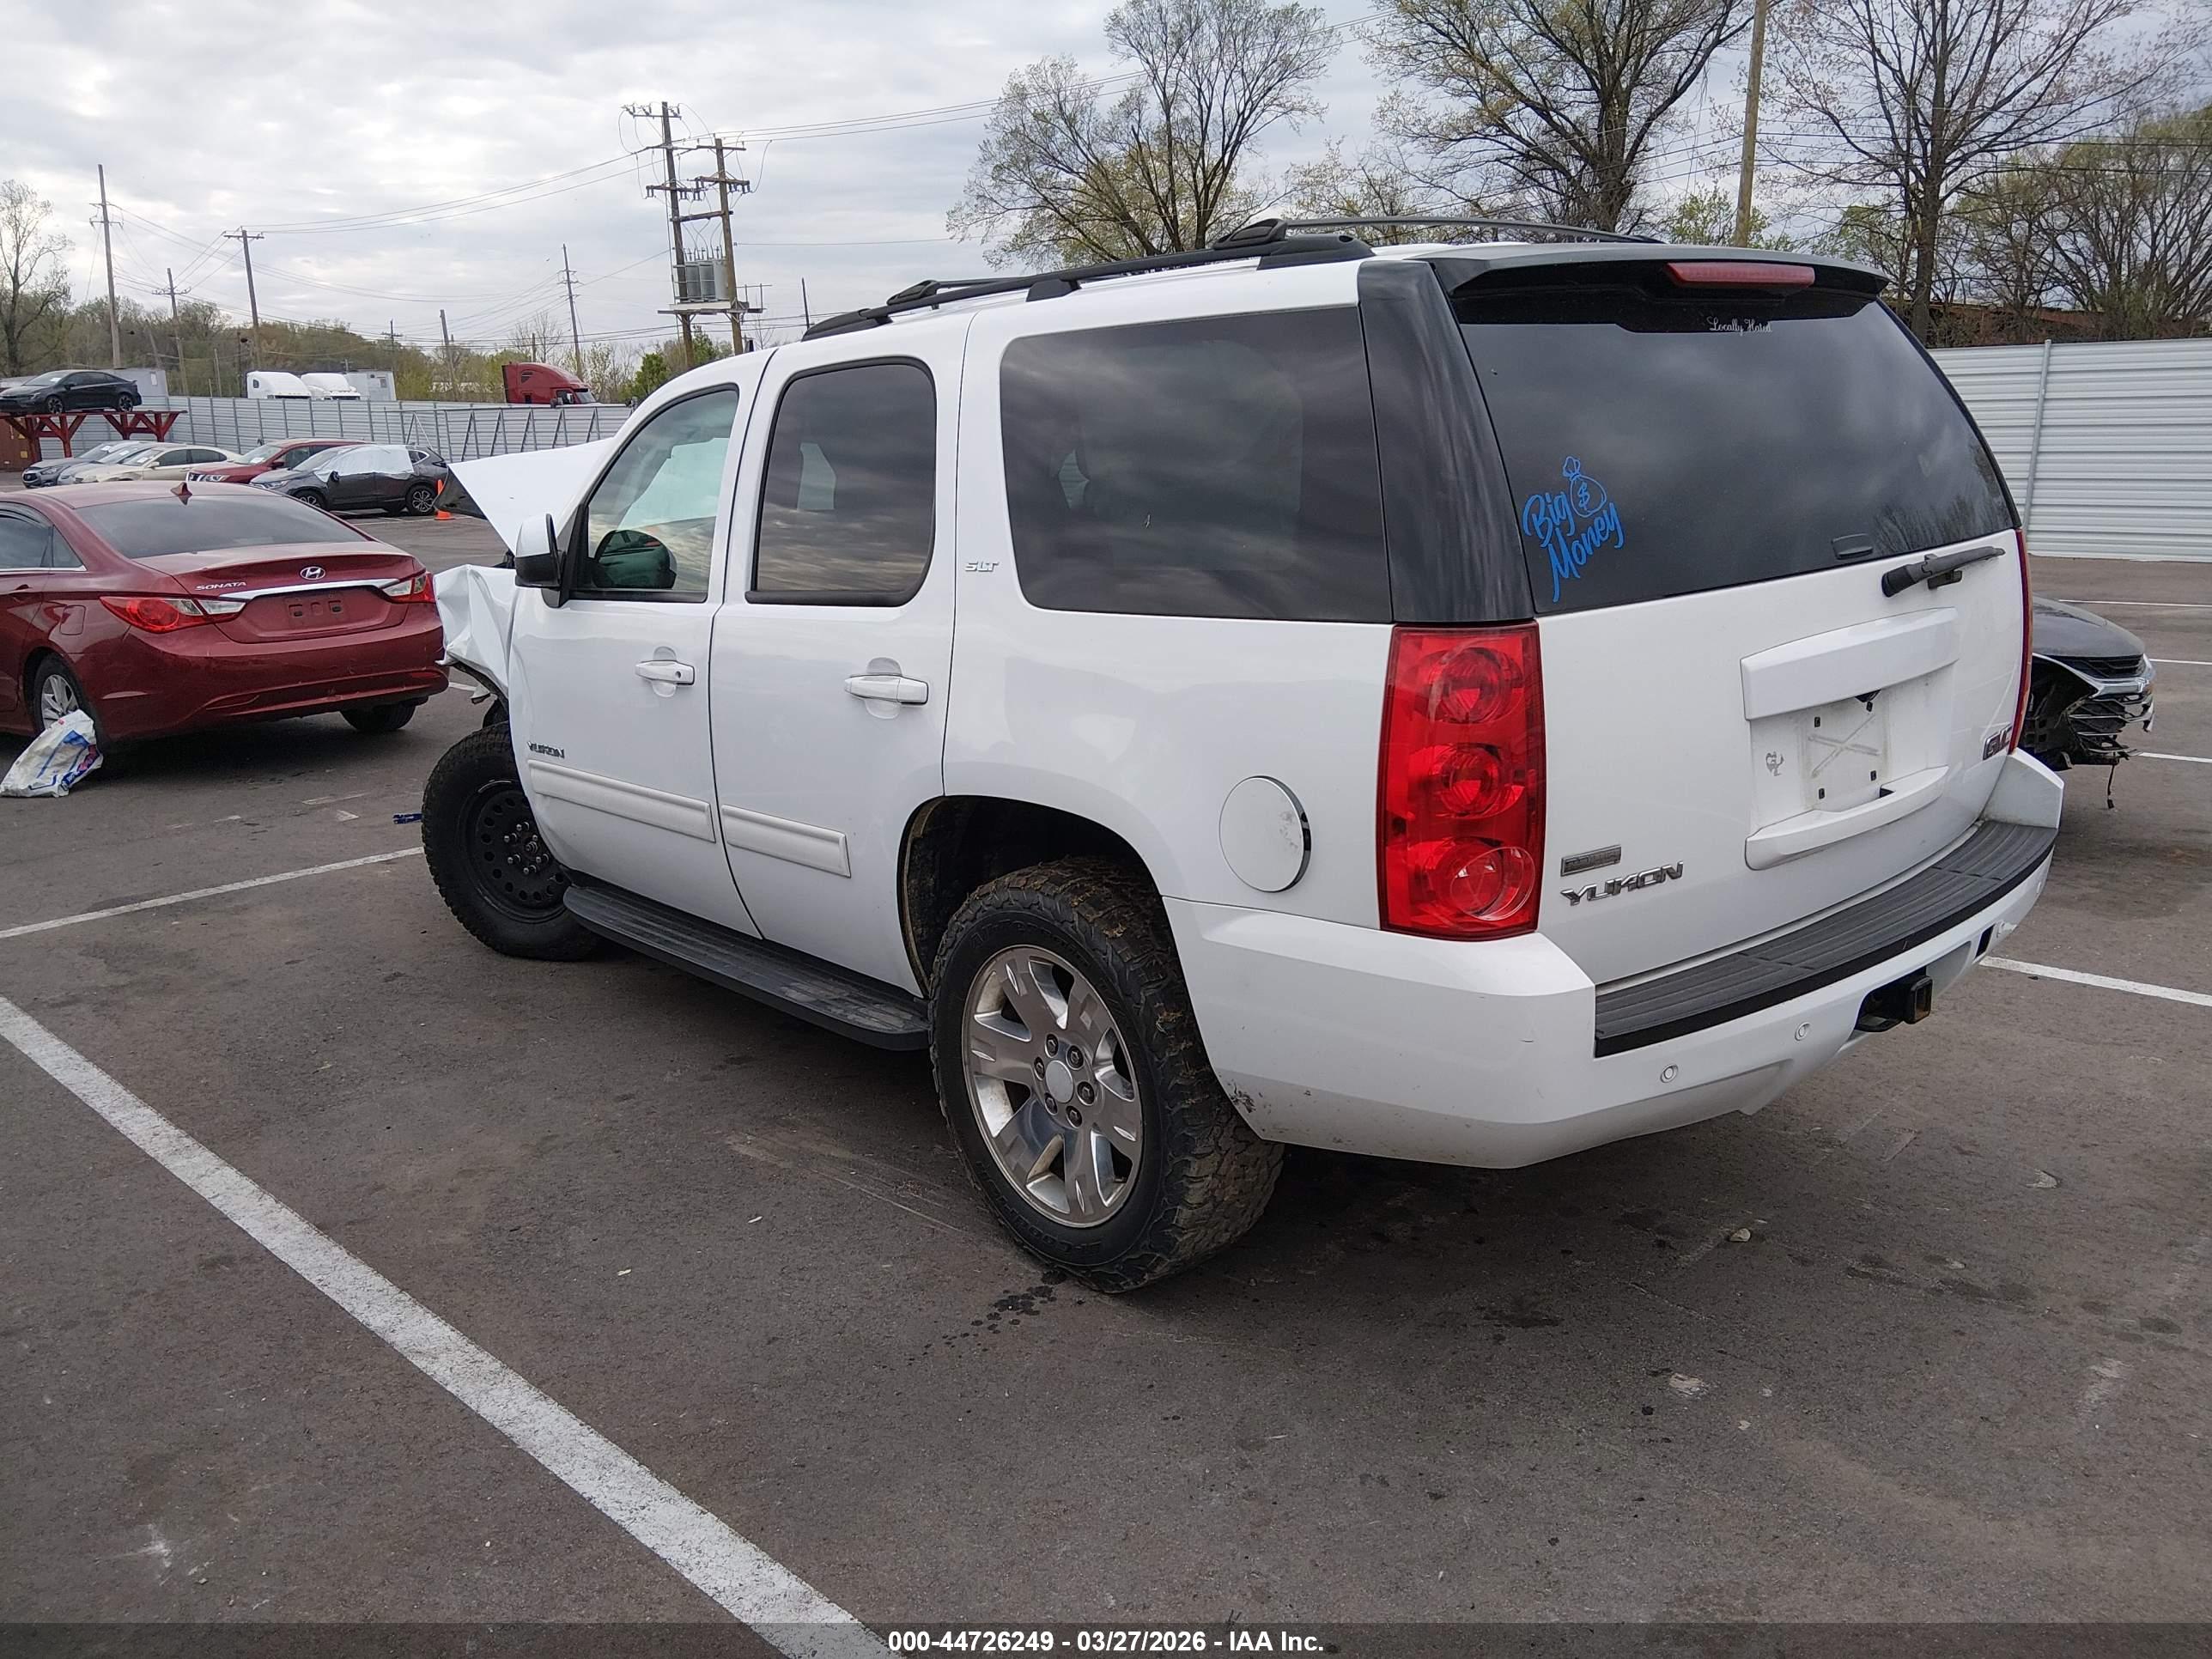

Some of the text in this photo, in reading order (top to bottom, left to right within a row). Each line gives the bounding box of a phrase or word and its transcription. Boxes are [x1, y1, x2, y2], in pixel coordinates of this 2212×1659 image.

[1522, 491, 1575, 547] Big
[964, 561, 1000, 573] SLT
[1548, 501, 1625, 602] Money
[195, 581, 247, 591] SONATA
[526, 741, 565, 759] YUKON
[1560, 860, 1683, 907] YUKON
